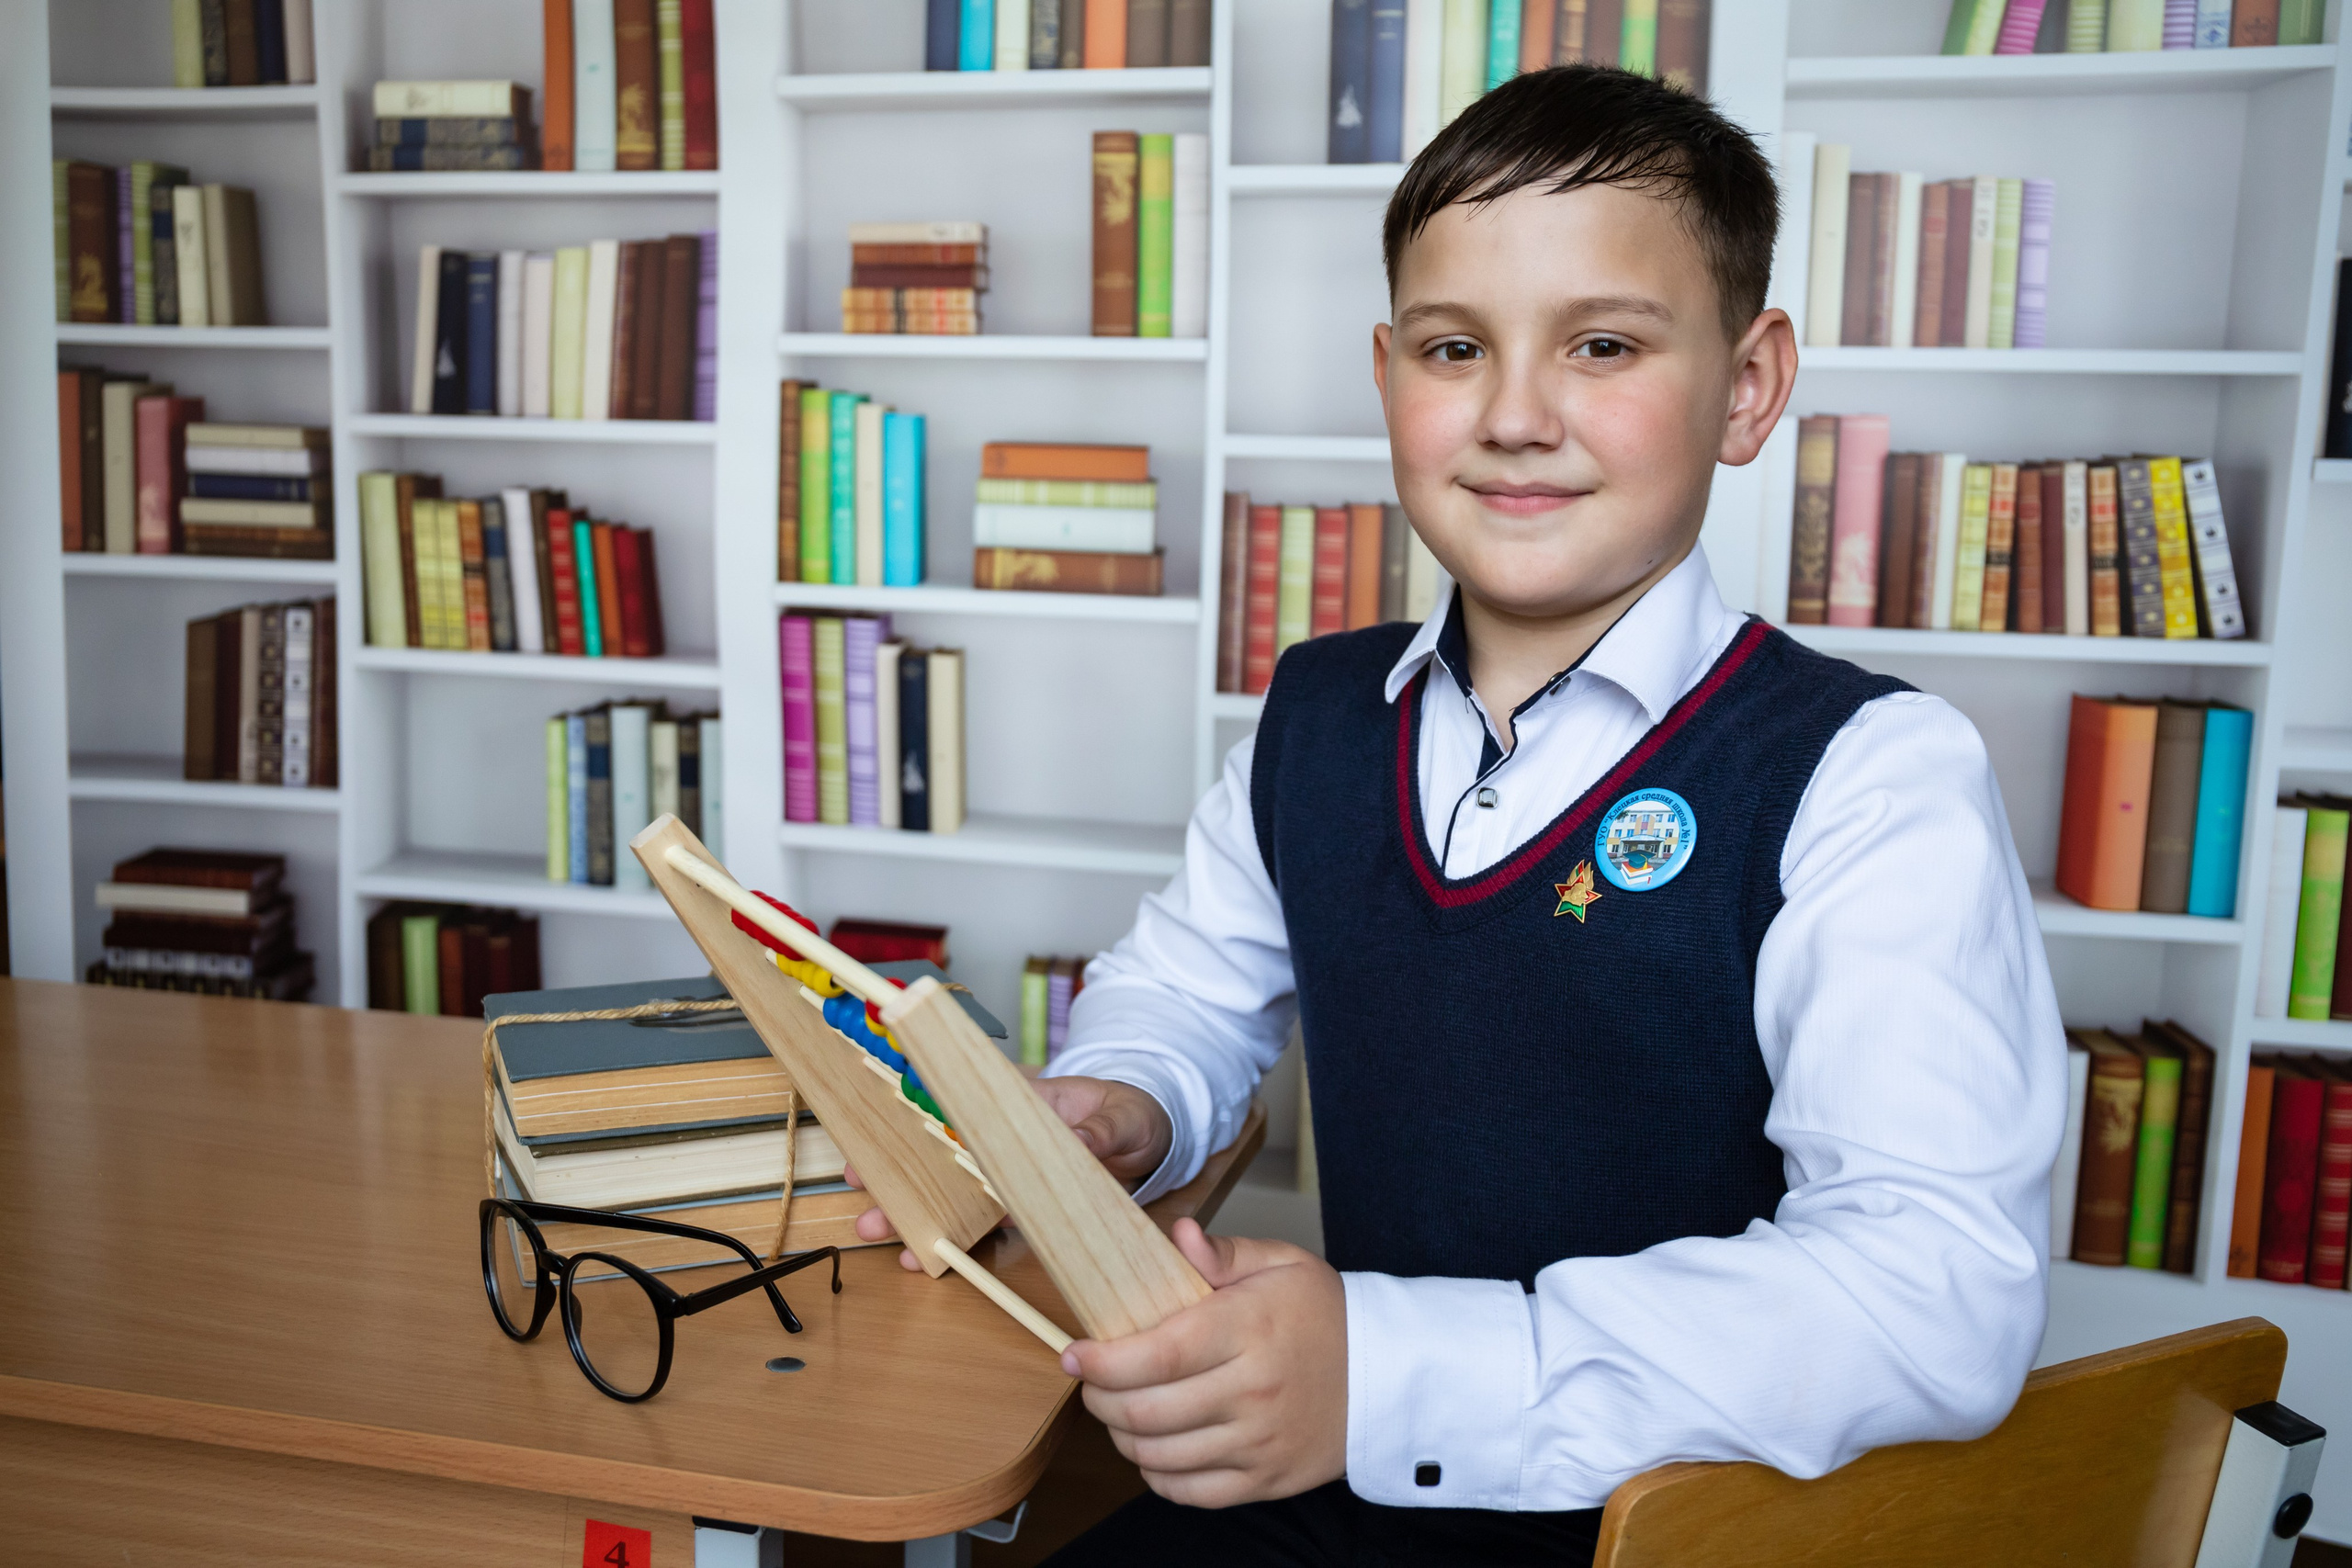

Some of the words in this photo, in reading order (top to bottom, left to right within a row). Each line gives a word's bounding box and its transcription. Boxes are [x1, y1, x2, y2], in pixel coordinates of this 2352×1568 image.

[1597, 826, 1608, 846] ГУО
[1641, 793, 1674, 805] средняя
[1671, 803, 1688, 827] школа
[604, 1540, 630, 1568] 4
